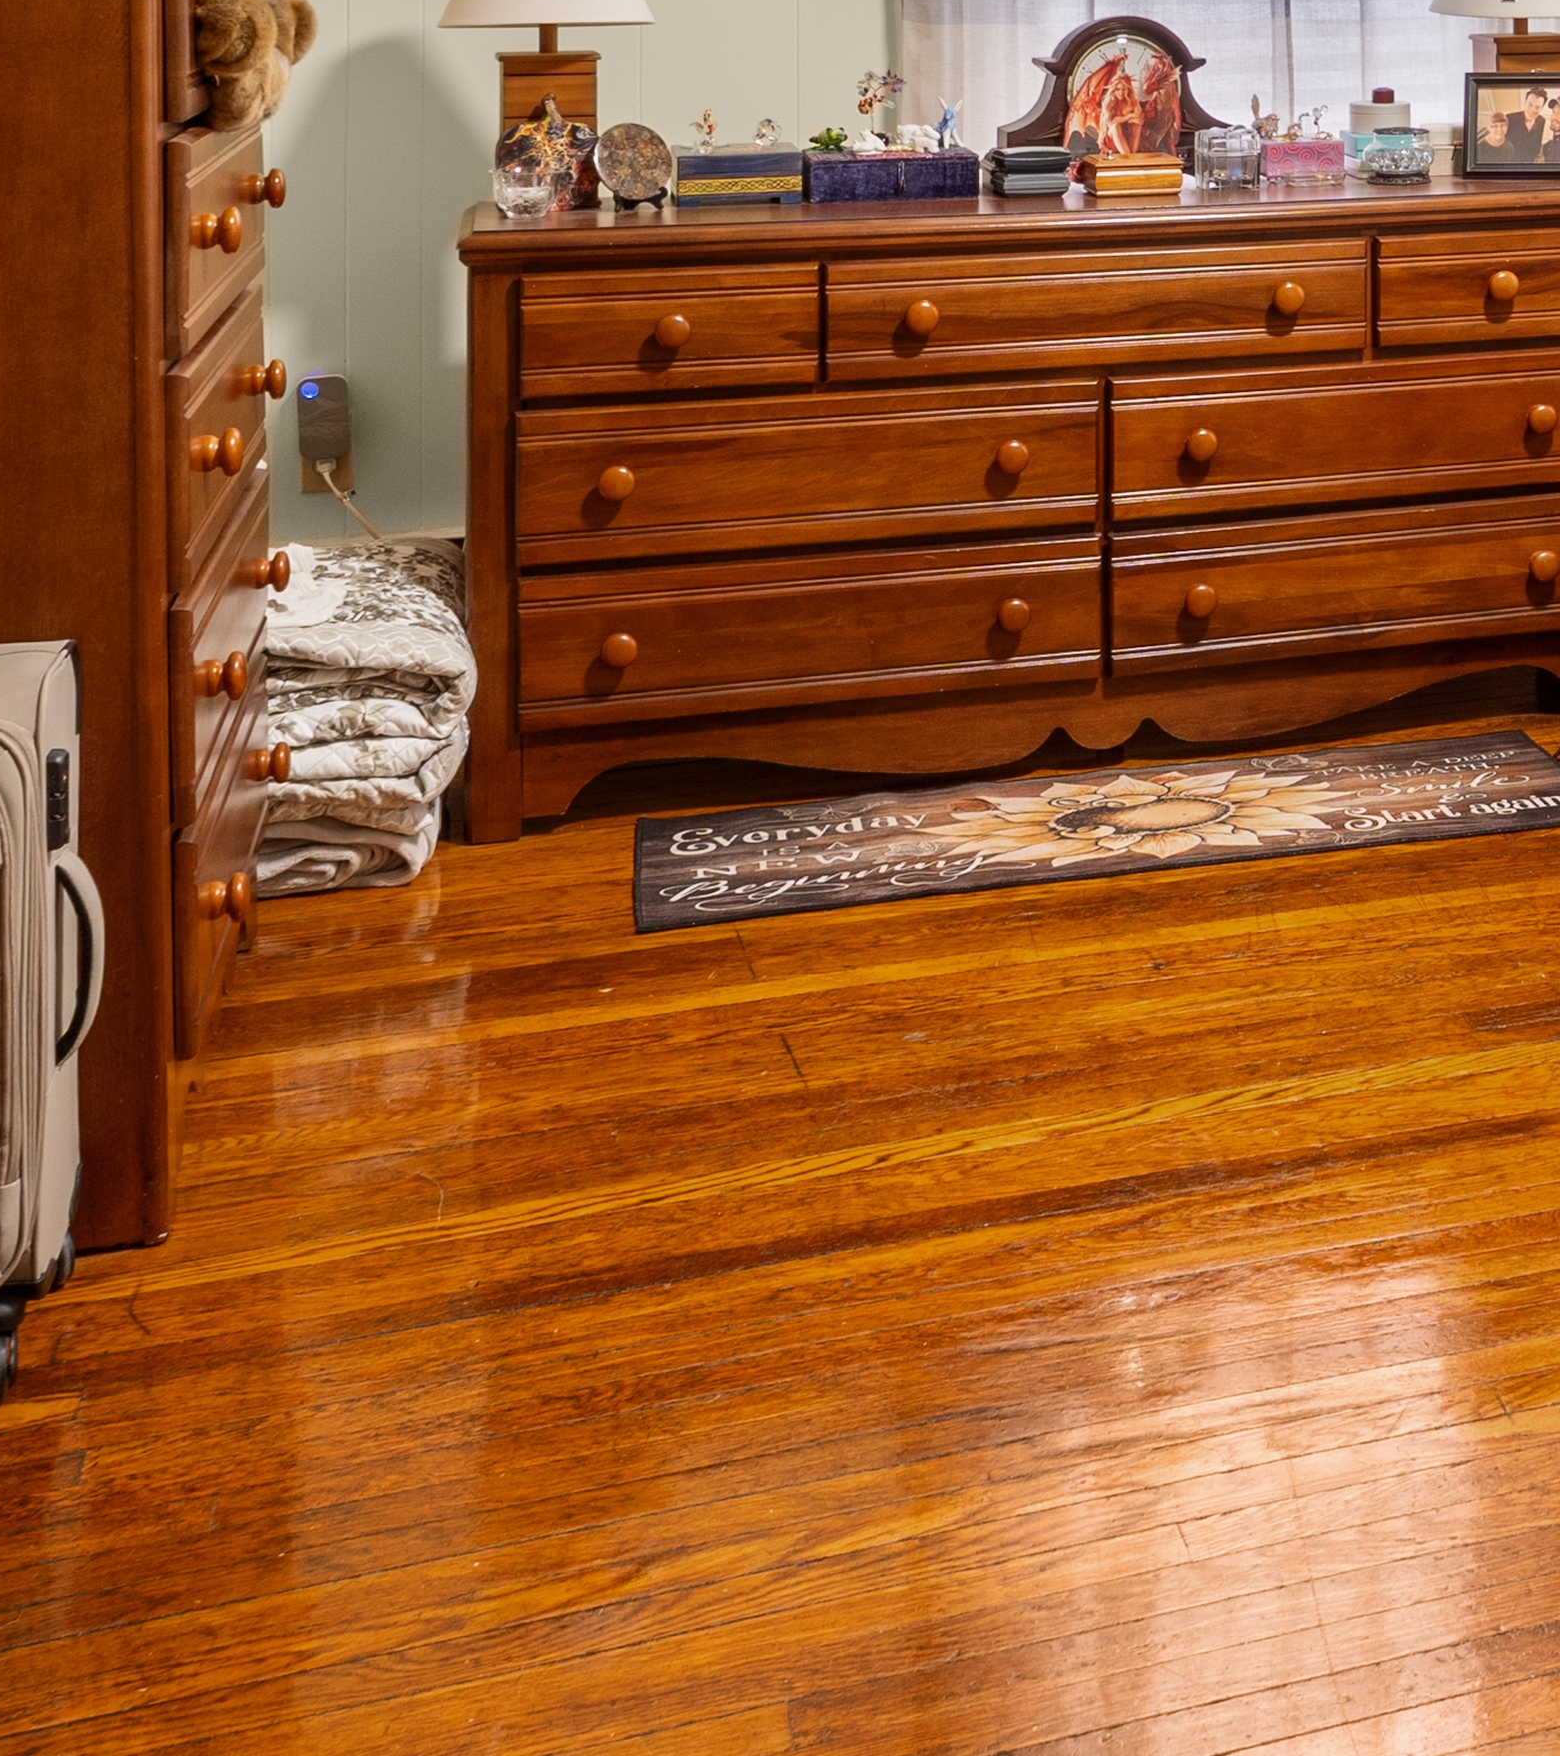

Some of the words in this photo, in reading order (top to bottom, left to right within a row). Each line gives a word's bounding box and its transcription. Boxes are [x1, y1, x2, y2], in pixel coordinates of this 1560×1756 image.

[1314, 763, 1397, 776] TAKE
[1444, 750, 1515, 764] DEEP
[1357, 771, 1530, 798] Smile
[1344, 805, 1462, 832] Start
[669, 813, 927, 856] Everyday
[757, 845, 801, 857] IS
[826, 841, 850, 851] A
[690, 850, 862, 880] NEW
[659, 855, 985, 911] Beginning
